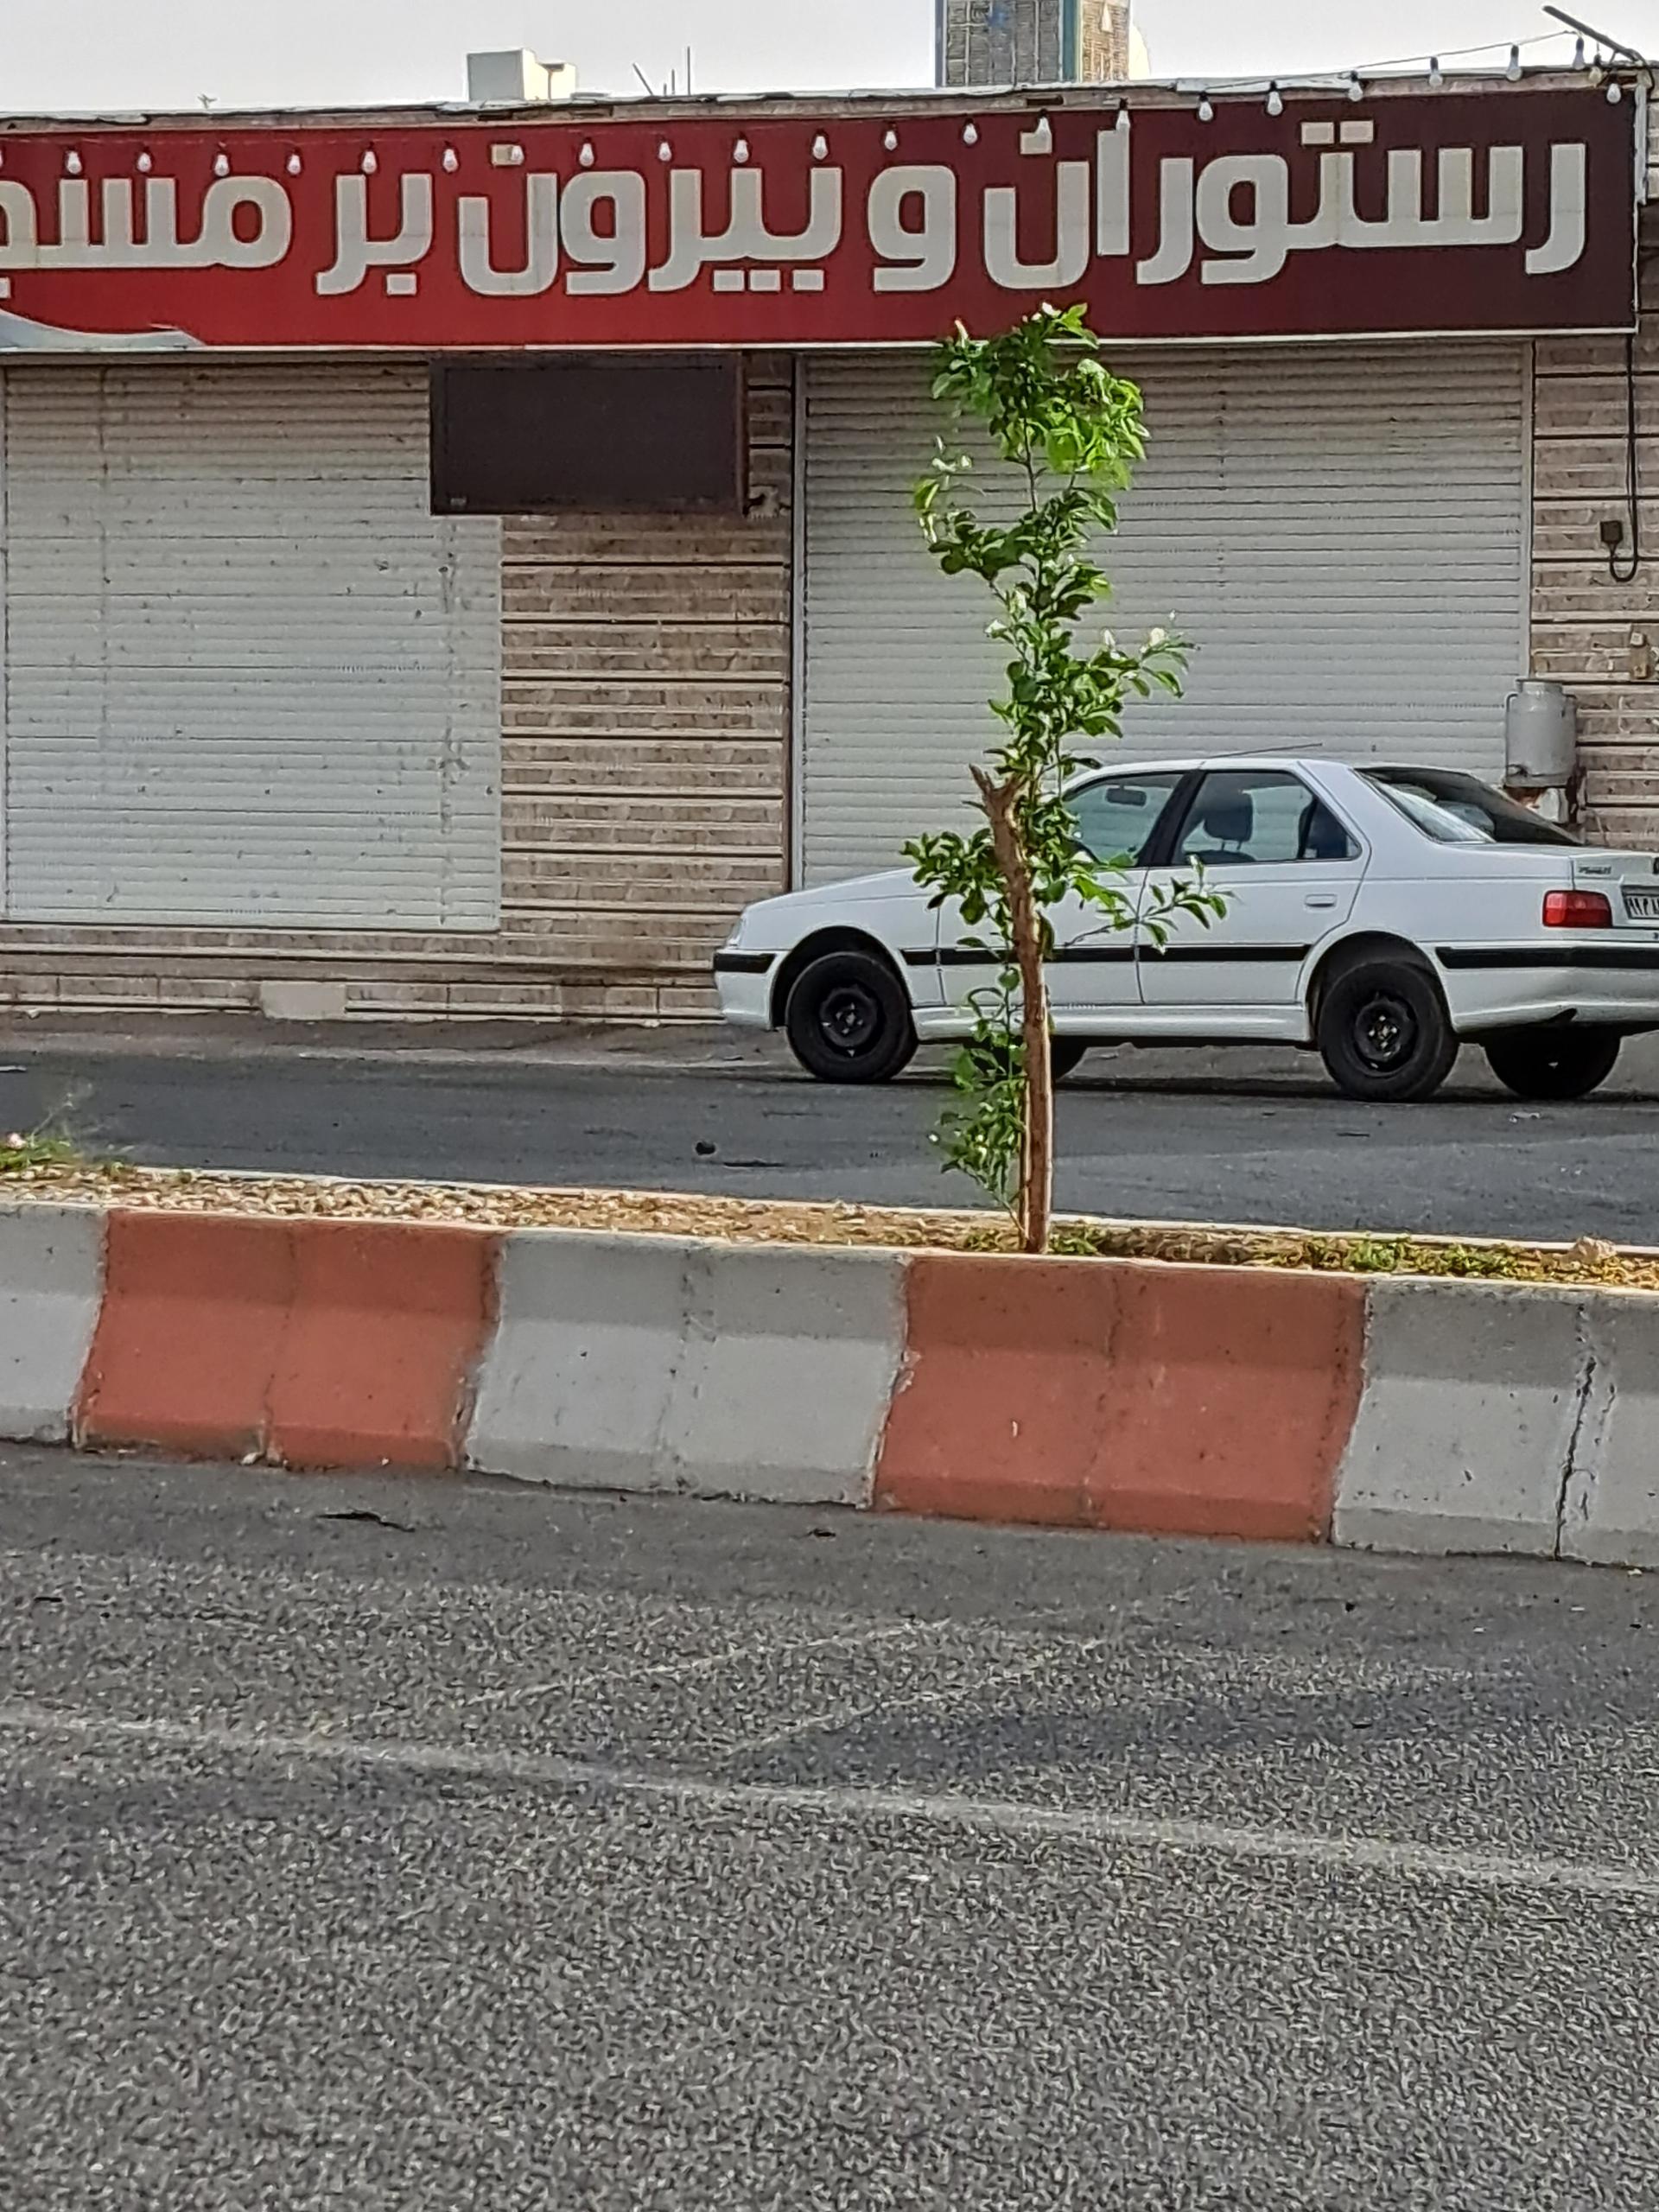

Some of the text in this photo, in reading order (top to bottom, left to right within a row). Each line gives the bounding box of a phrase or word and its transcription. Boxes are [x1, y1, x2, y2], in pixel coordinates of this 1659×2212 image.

[315, 173, 432, 296] بر
[458, 143, 842, 296] بیرون
[867, 164, 957, 292] و
[983, 119, 1586, 290] رستوران
